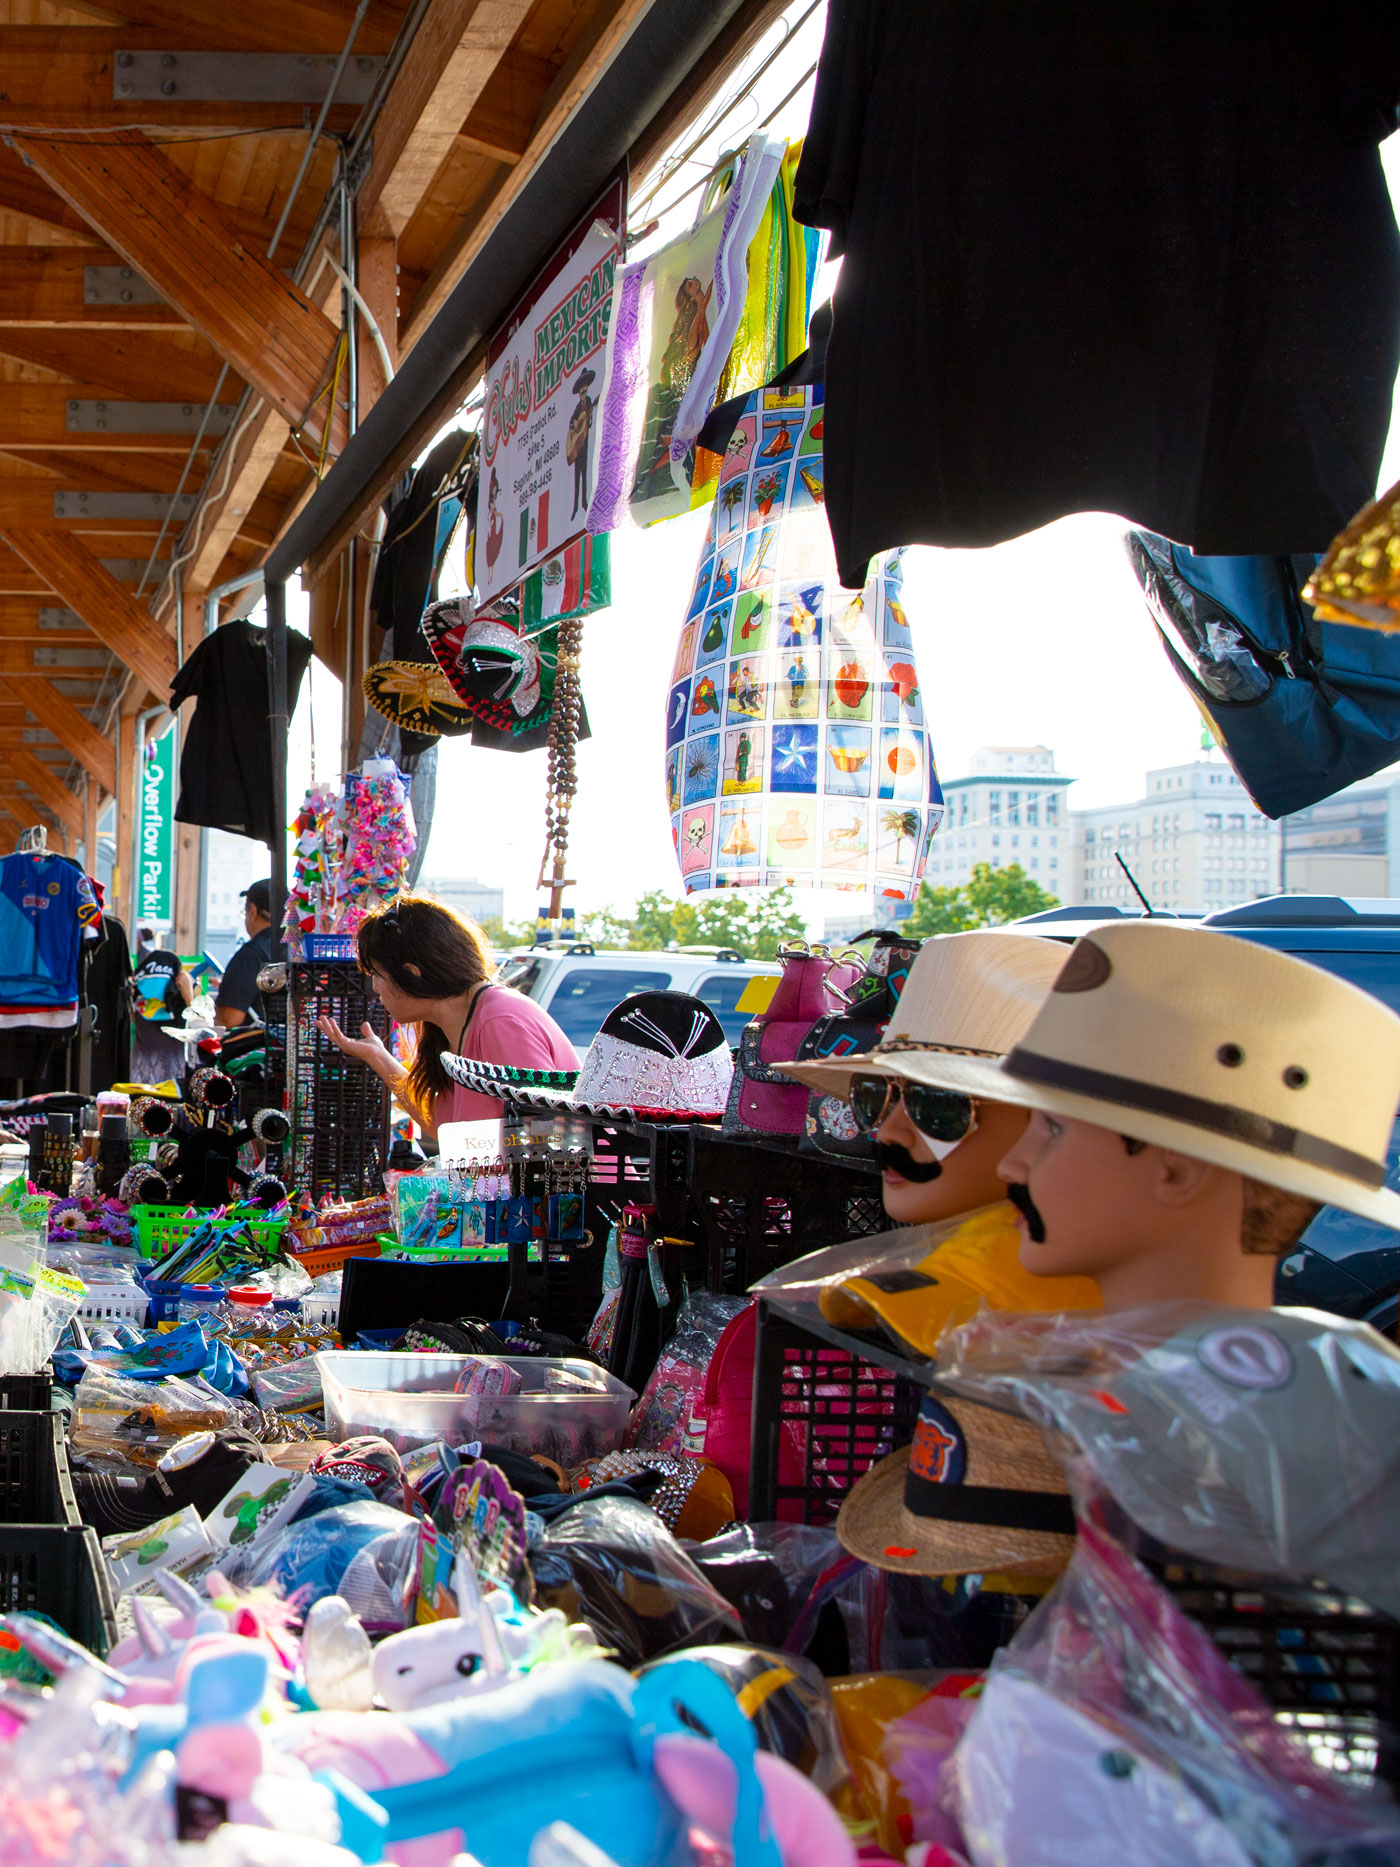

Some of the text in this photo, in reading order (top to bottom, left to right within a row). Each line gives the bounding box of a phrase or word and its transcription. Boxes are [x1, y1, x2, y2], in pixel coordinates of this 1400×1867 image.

[536, 252, 616, 365] MEXICAN
[536, 298, 613, 404] IMPORTS
[144, 764, 165, 857] Overflow
[143, 861, 162, 920] Parkin
[464, 1131, 563, 1150] Key chains
